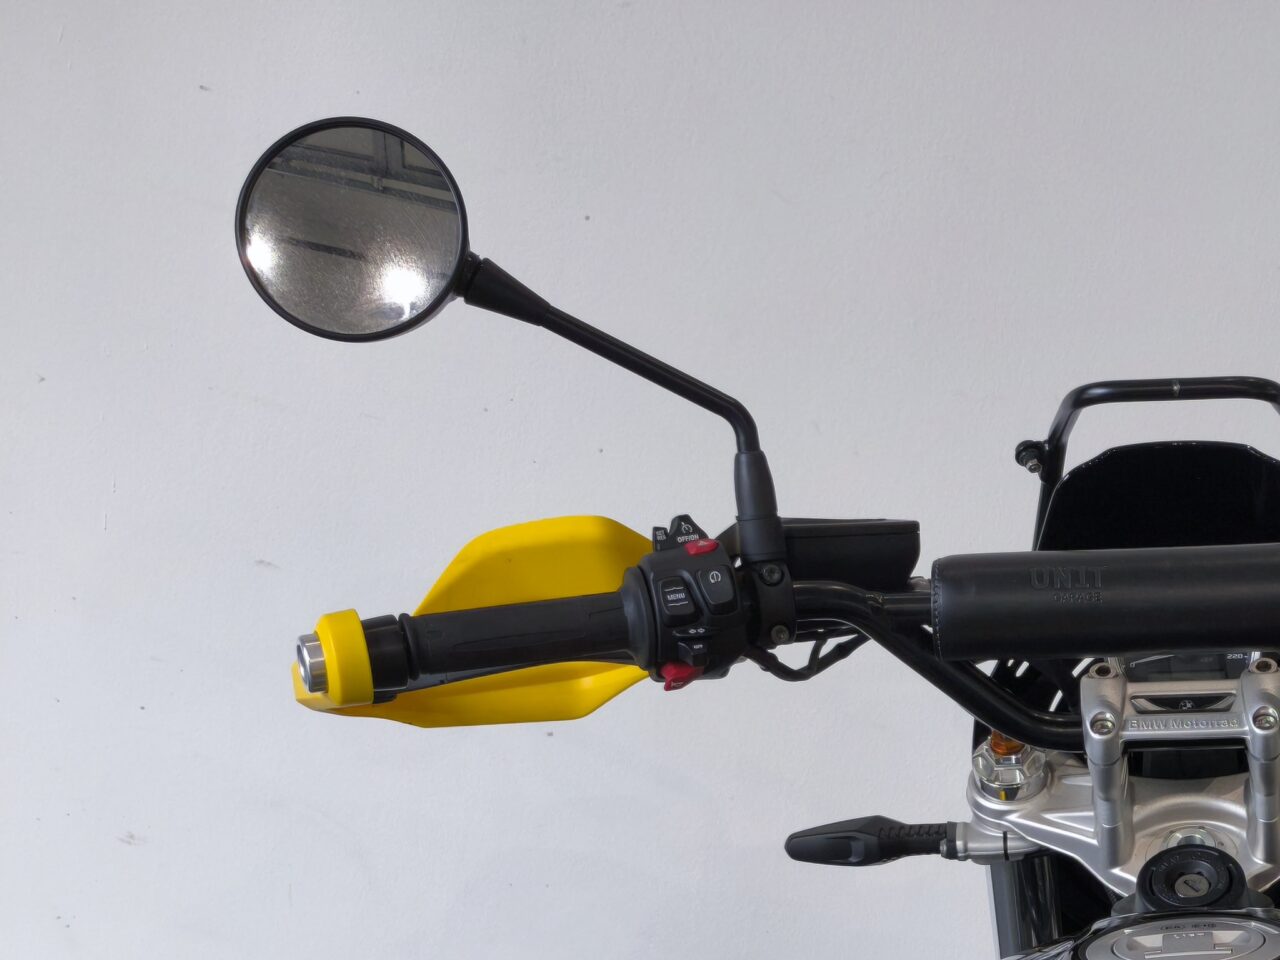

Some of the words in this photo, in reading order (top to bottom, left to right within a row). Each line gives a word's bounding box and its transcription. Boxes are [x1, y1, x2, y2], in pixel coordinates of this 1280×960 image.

[1029, 566, 1103, 591] UNIT
[667, 593, 686, 601] MENU
[1128, 719, 1166, 730] BMW
[1169, 718, 1239, 730] Motorrad
